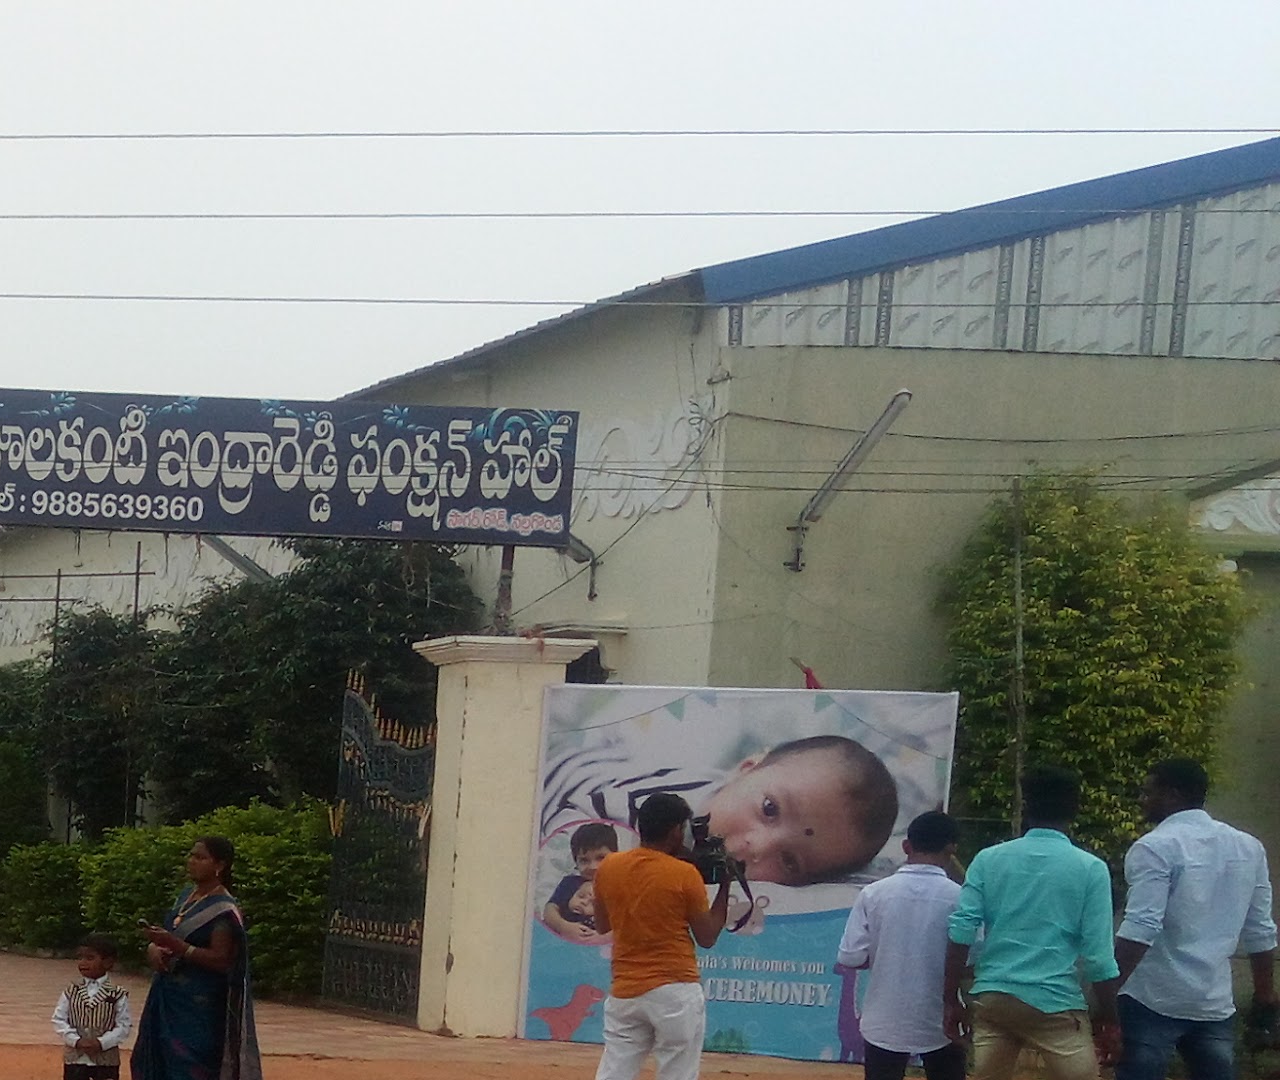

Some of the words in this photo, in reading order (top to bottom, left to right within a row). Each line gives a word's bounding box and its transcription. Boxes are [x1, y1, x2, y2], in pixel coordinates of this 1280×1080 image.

[157, 416, 339, 523] ఇంద్రారెడ్డి
[346, 419, 473, 532] ఫంక్షన్
[479, 418, 570, 502] హాల్
[31, 489, 204, 522] 9885639360
[801, 962, 825, 975] you
[706, 978, 831, 1006] CEREMONEY
